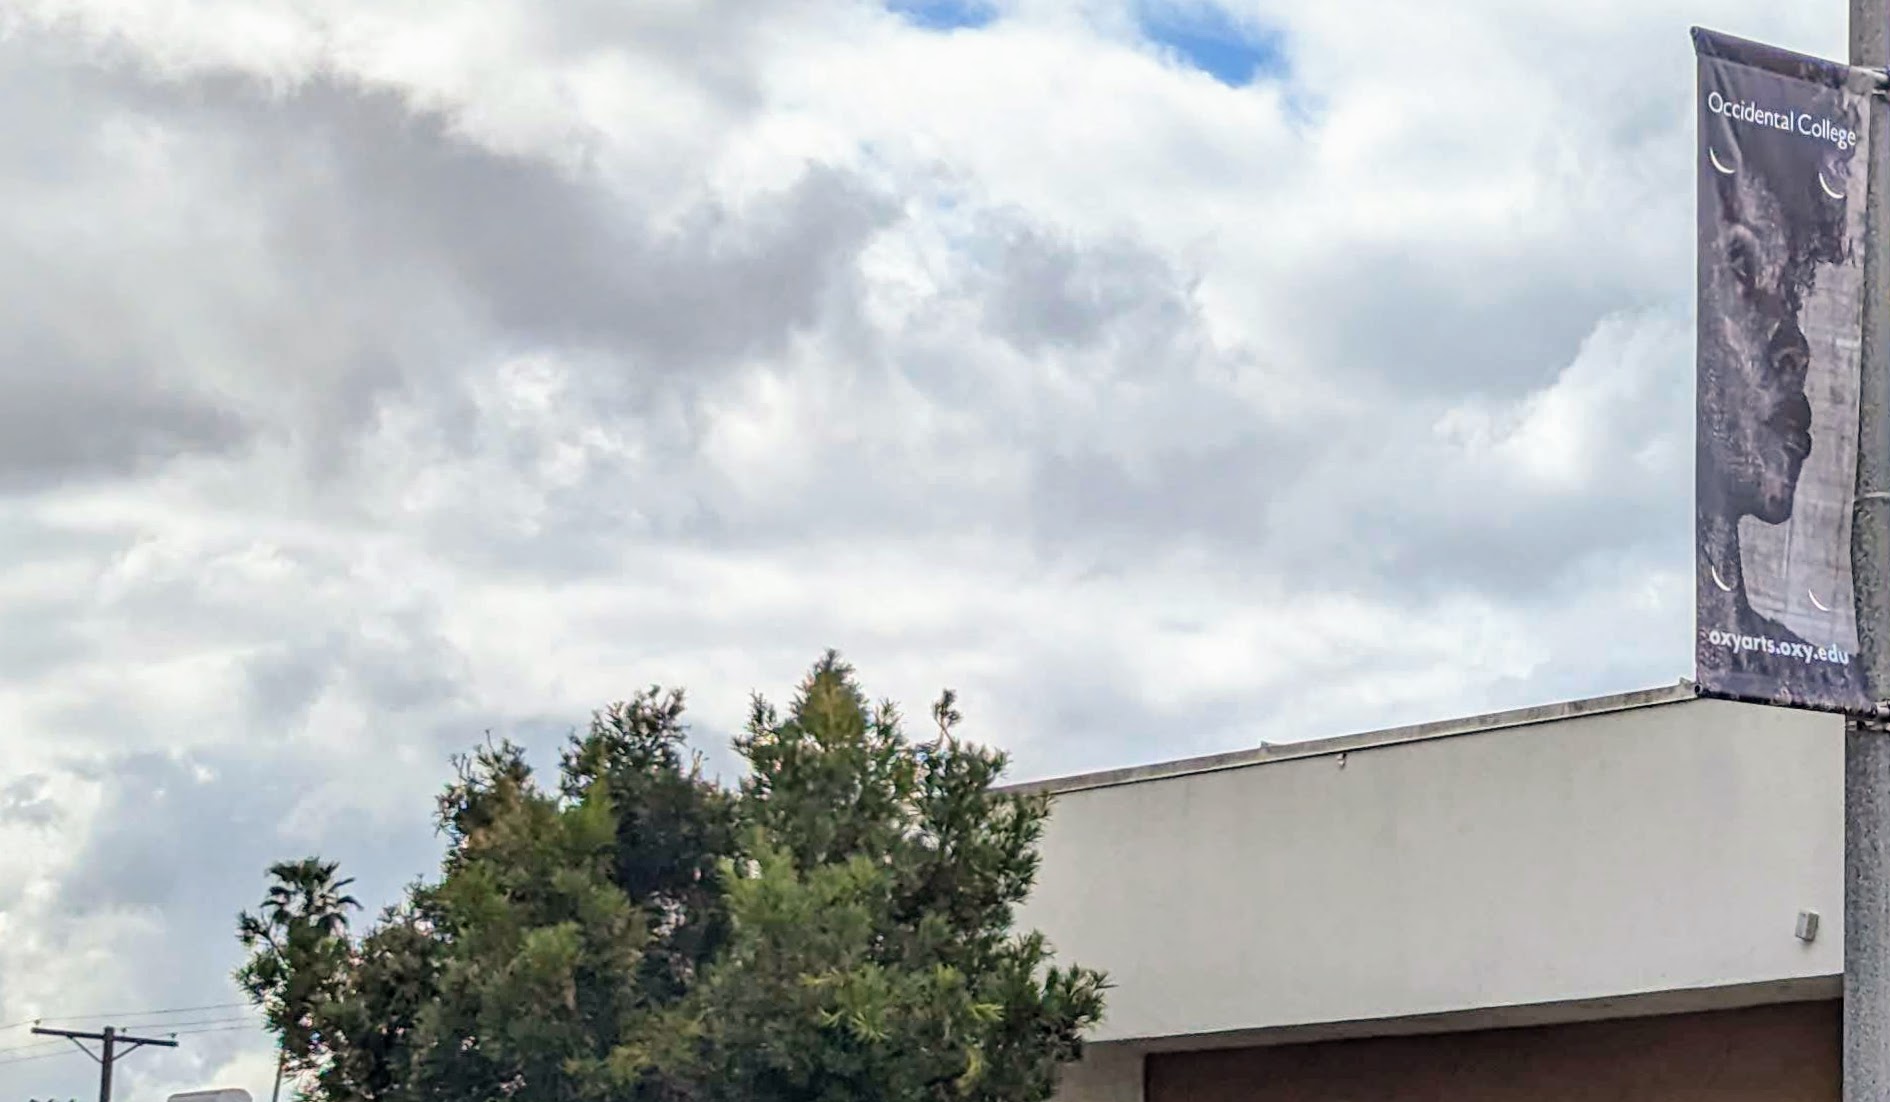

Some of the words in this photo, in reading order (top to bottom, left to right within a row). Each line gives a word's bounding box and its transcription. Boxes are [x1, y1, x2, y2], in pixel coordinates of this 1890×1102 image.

[1708, 91, 1794, 132] Occidental
[1797, 114, 1857, 150] College
[1709, 630, 1850, 665] oxyarts.oxy.edu
